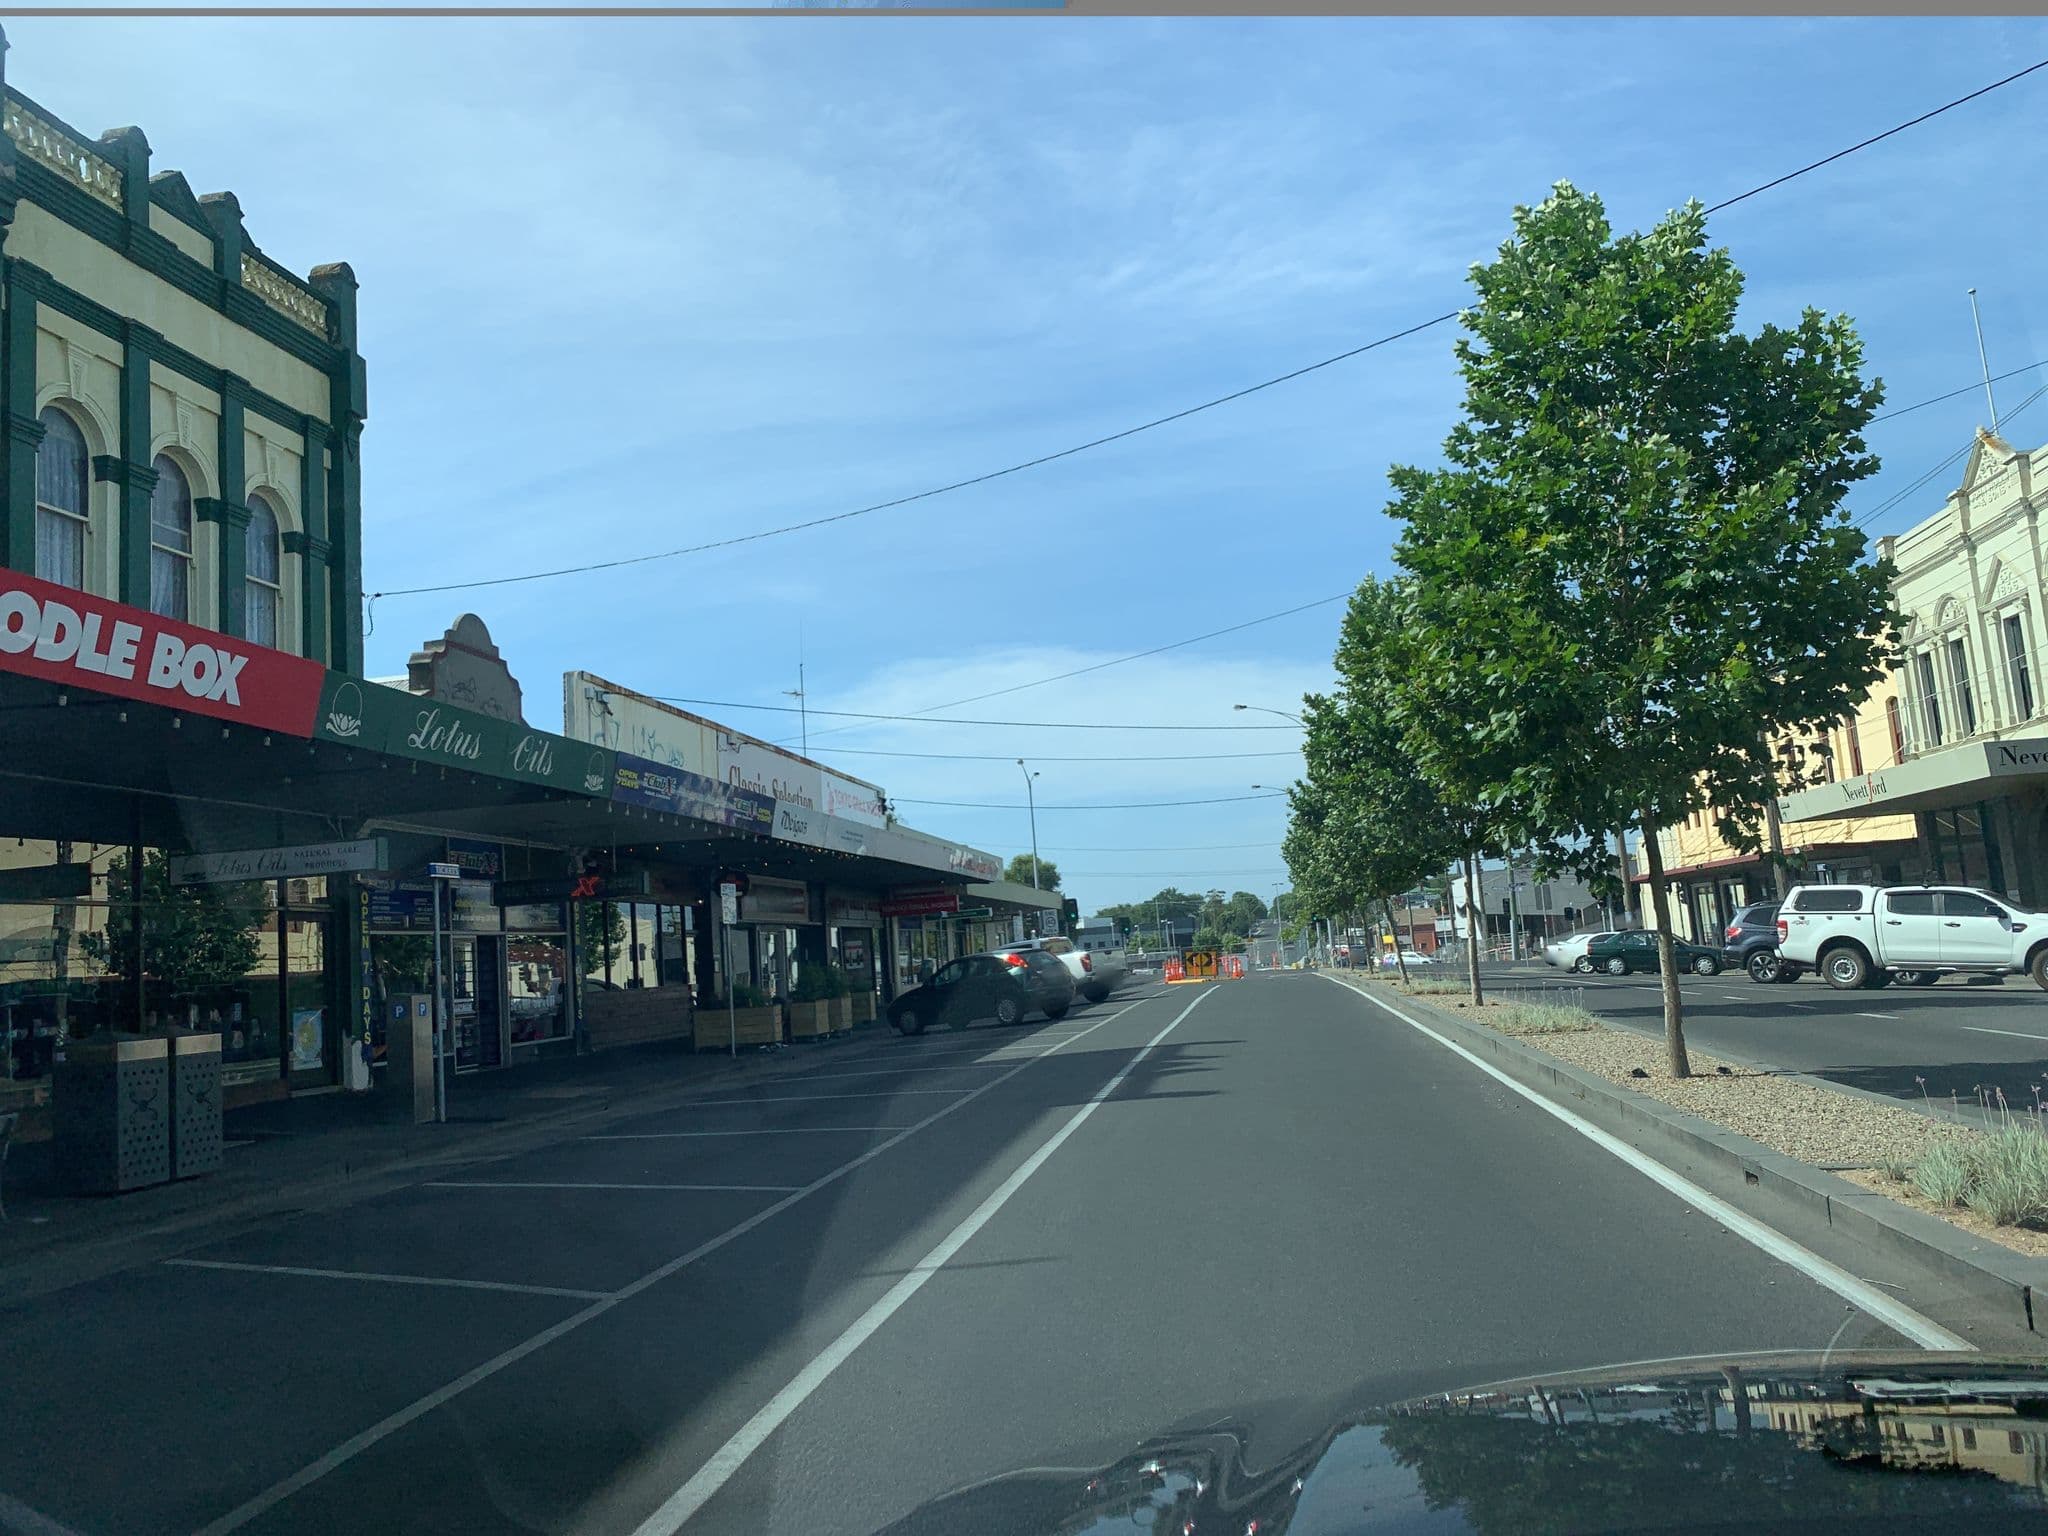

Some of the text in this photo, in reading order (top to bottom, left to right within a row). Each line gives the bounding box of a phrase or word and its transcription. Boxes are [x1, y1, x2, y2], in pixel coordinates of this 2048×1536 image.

[148, 632, 249, 707] BOX
[407, 708, 554, 776] Lotus Oils
[618, 768, 639, 780] OPEN
[361, 891, 371, 949] OPEN
[362, 986, 372, 1045] DAYS
[394, 1005, 404, 1017] P
